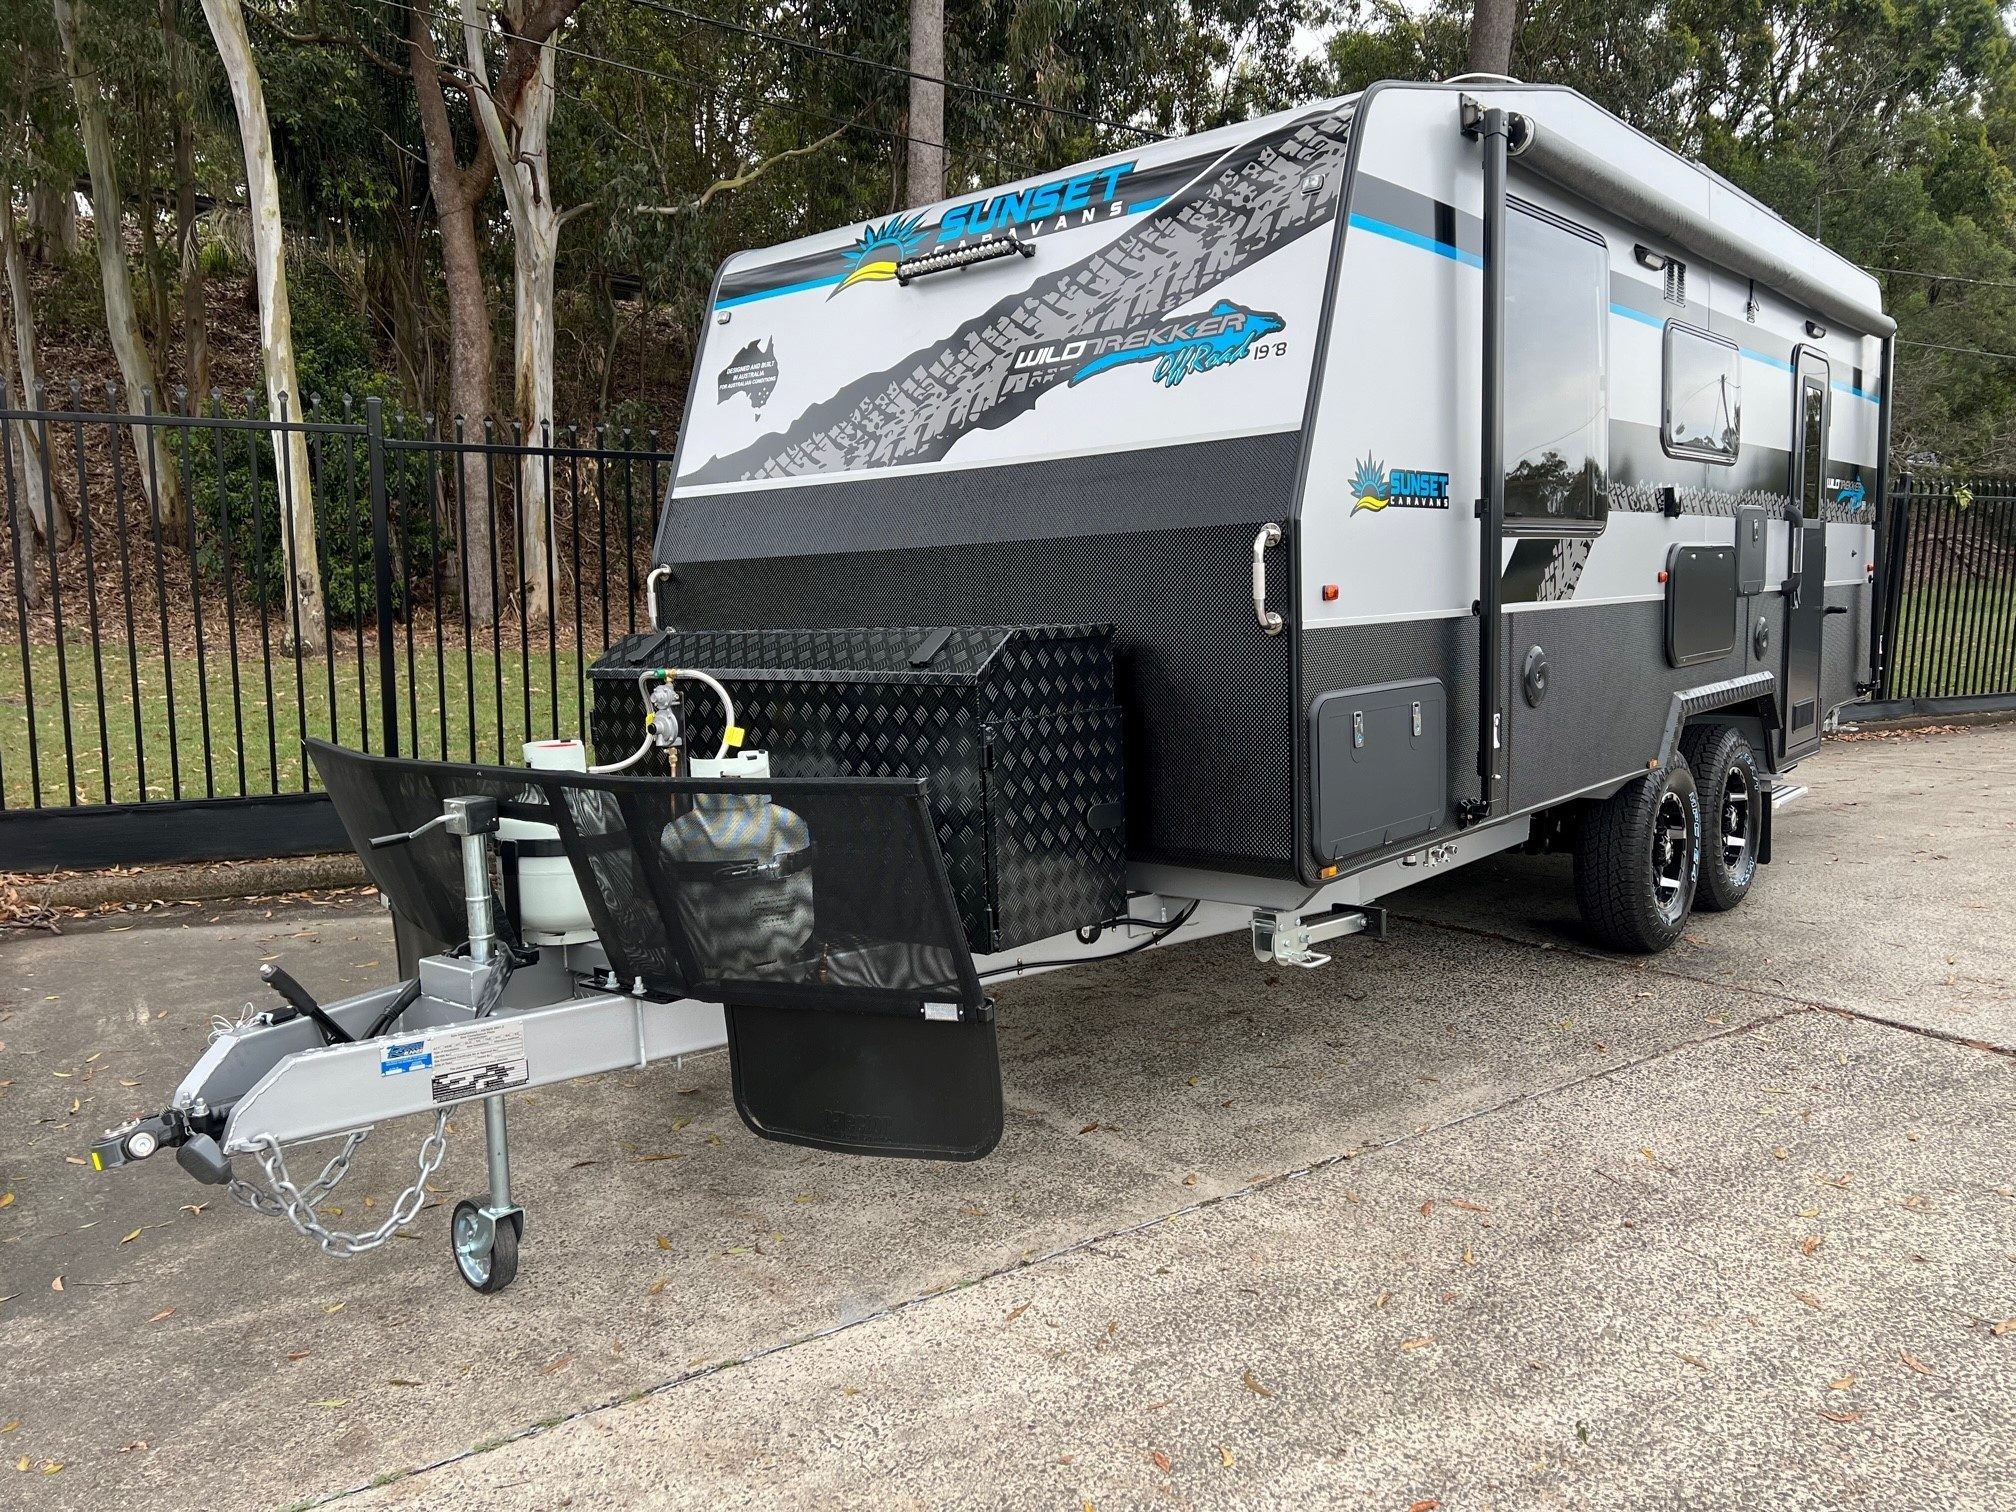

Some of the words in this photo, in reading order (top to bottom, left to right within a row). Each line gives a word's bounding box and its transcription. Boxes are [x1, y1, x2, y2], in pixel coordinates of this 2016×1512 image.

[936, 160, 1138, 243] SUNSET
[726, 364, 750, 375] DESIGNED
[750, 362, 761, 371] AND
[761, 360, 775, 369] BUILT
[739, 370, 765, 379] AUSTRALIA
[719, 383, 728, 391] FOR
[728, 380, 752, 389] AUSTRALIAN
[752, 375, 777, 385] CONDITIONS
[1389, 471, 1448, 498] SUNSET
[1390, 495, 1449, 508] CARAVANS
